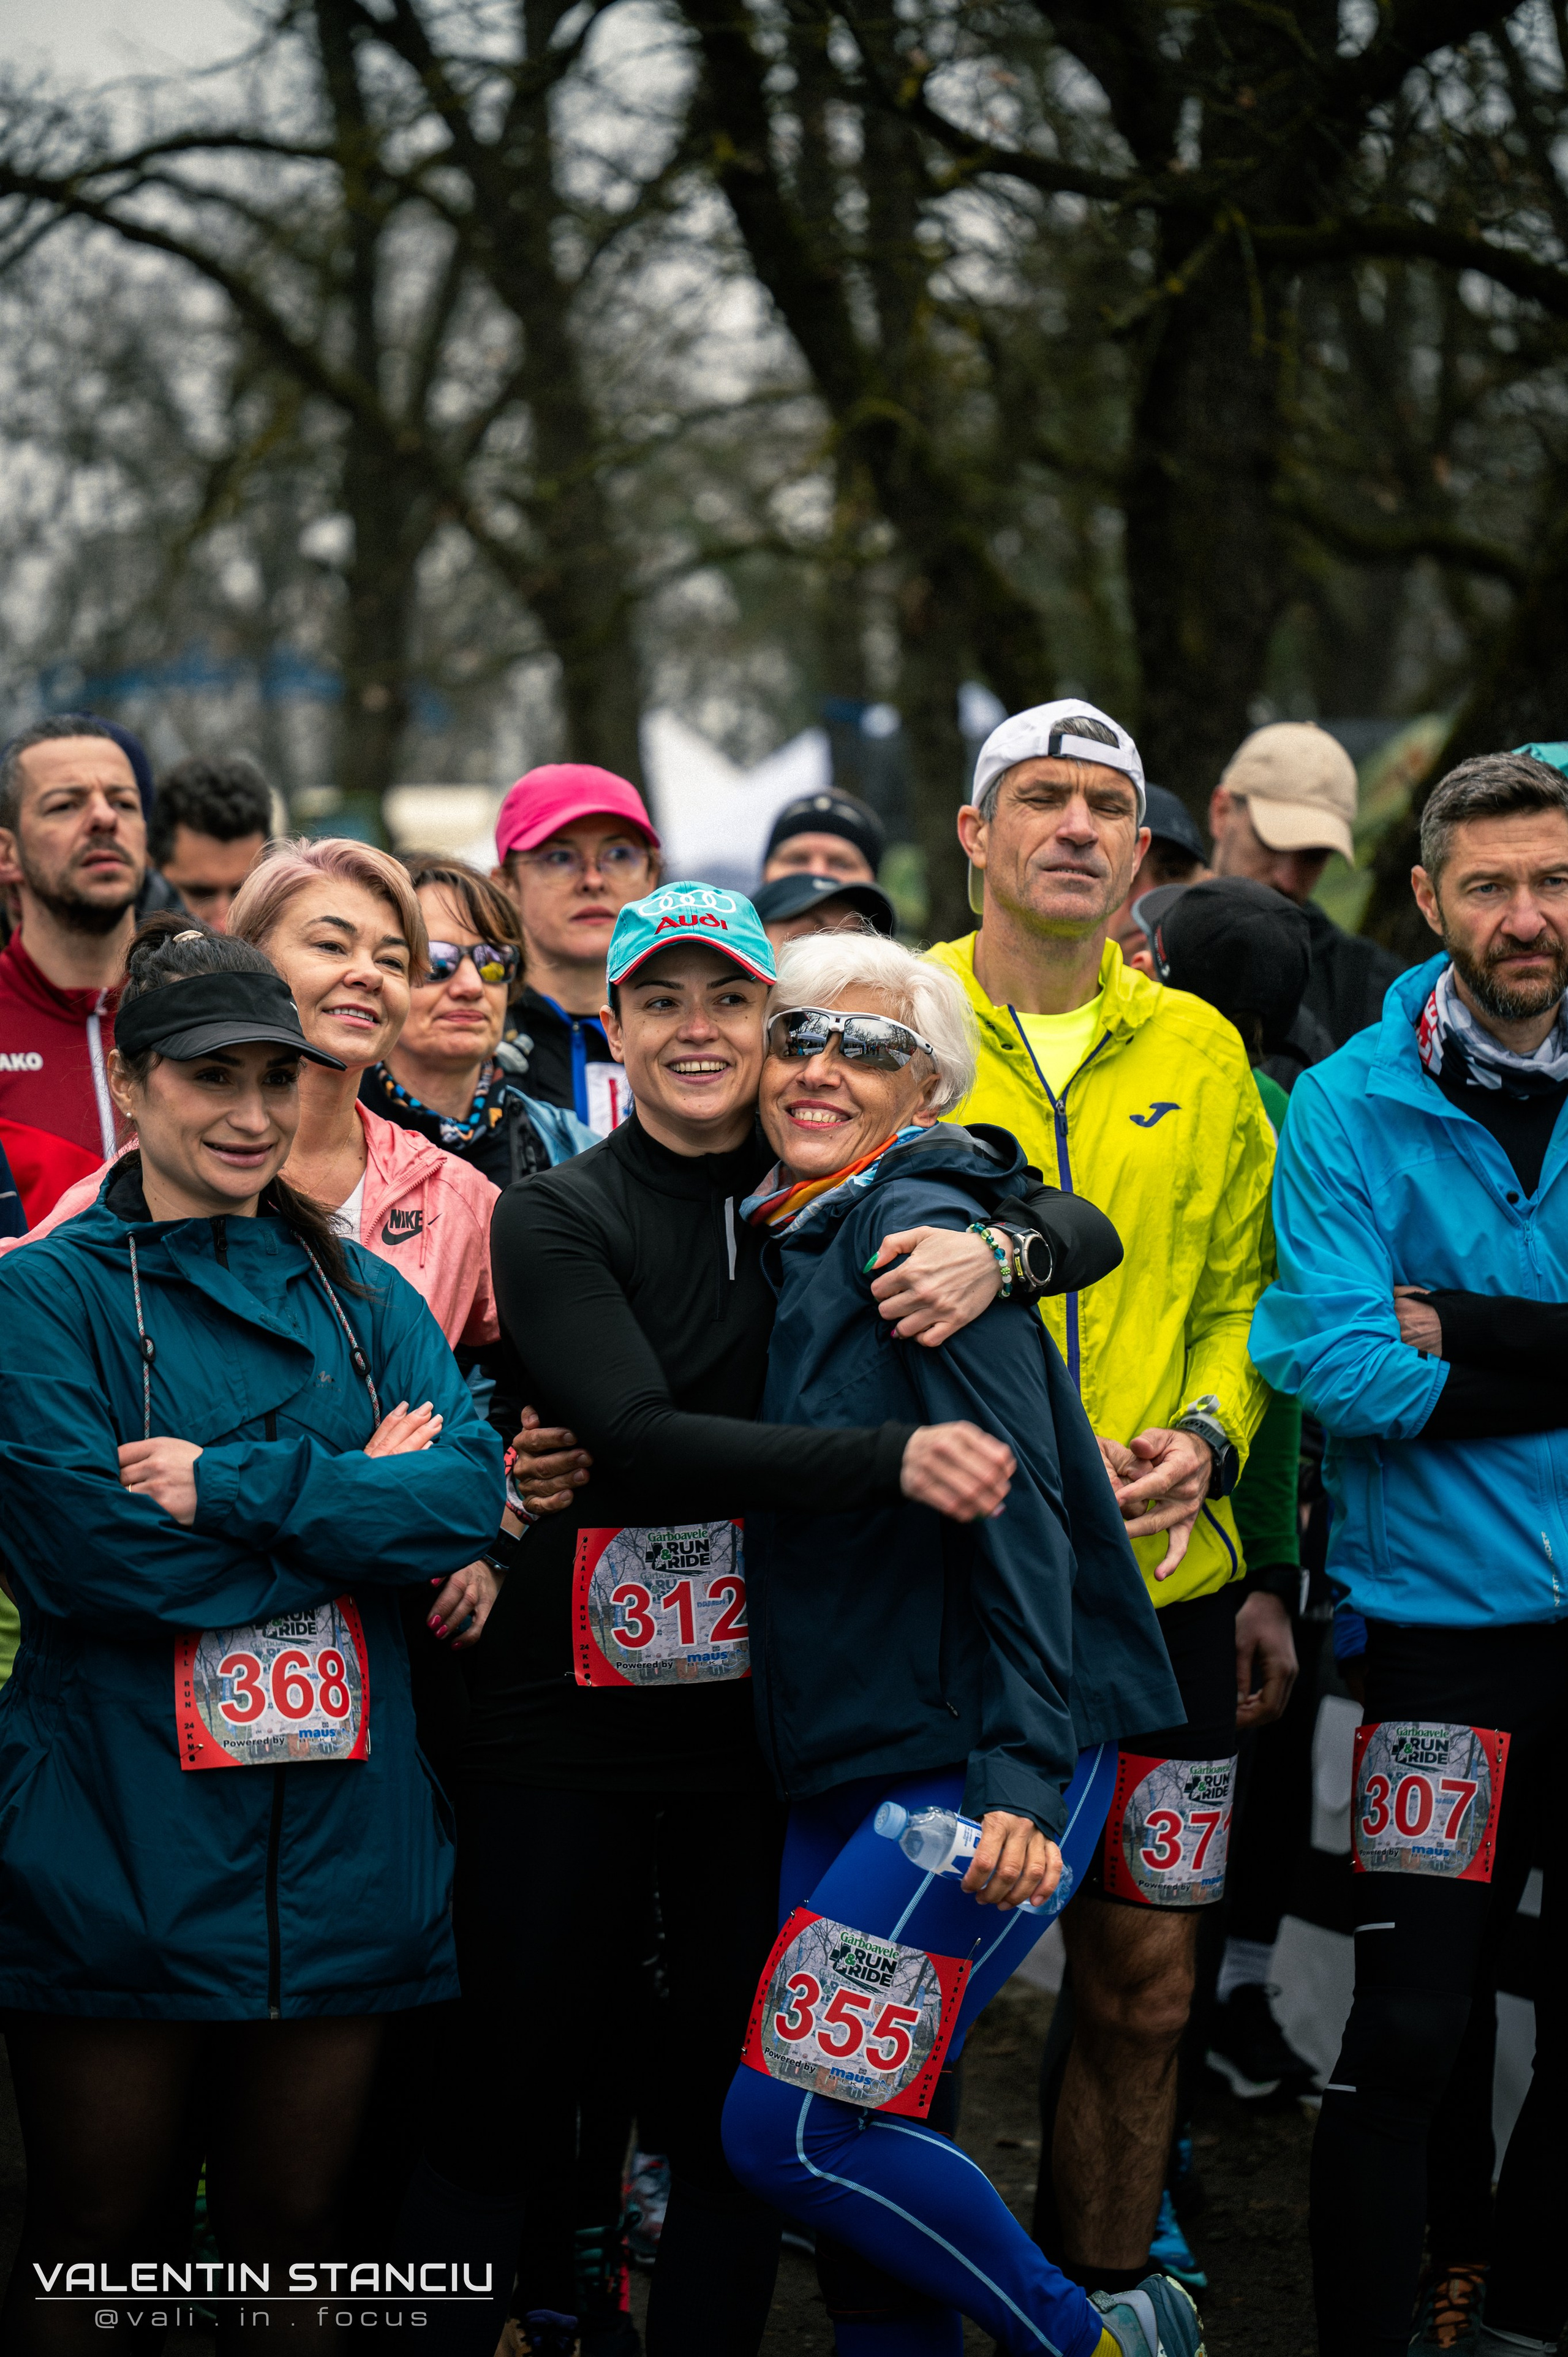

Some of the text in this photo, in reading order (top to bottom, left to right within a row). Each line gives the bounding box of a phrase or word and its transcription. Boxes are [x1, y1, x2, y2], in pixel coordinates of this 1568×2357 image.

[389, 1209, 423, 1229] NIKE
[647, 1530, 708, 1542] Gârboavele
[666, 1539, 710, 1555] RUN
[668, 1553, 710, 1569] RIDE
[611, 1574, 749, 1650] 312
[279, 1622, 317, 1636] RIDE
[687, 1651, 728, 1662] maus
[662, 1661, 673, 1669] by
[217, 1648, 352, 1725] 368
[299, 1729, 336, 1738] maus
[1396, 1727, 1449, 1738] Gârboavele
[223, 1735, 285, 1748] Powered by
[1411, 1738, 1449, 1752] RUN
[1409, 1752, 1449, 1765] RIDE
[1205, 1773, 1231, 1787] RUN
[1202, 1786, 1229, 1800] RIDE
[1362, 1773, 1478, 1841] 307
[1389, 1849, 1400, 1857] by
[1412, 1846, 1450, 1857] maus
[1139, 1879, 1191, 1892] Powered by
[840, 1931, 899, 1959] Gârboavele
[854, 1948, 897, 1974] RUN
[848, 1964, 893, 1988] RIDE
[774, 1971, 921, 2073] 355
[764, 2046, 816, 2074] Powered by
[830, 2067, 872, 2086] maus
